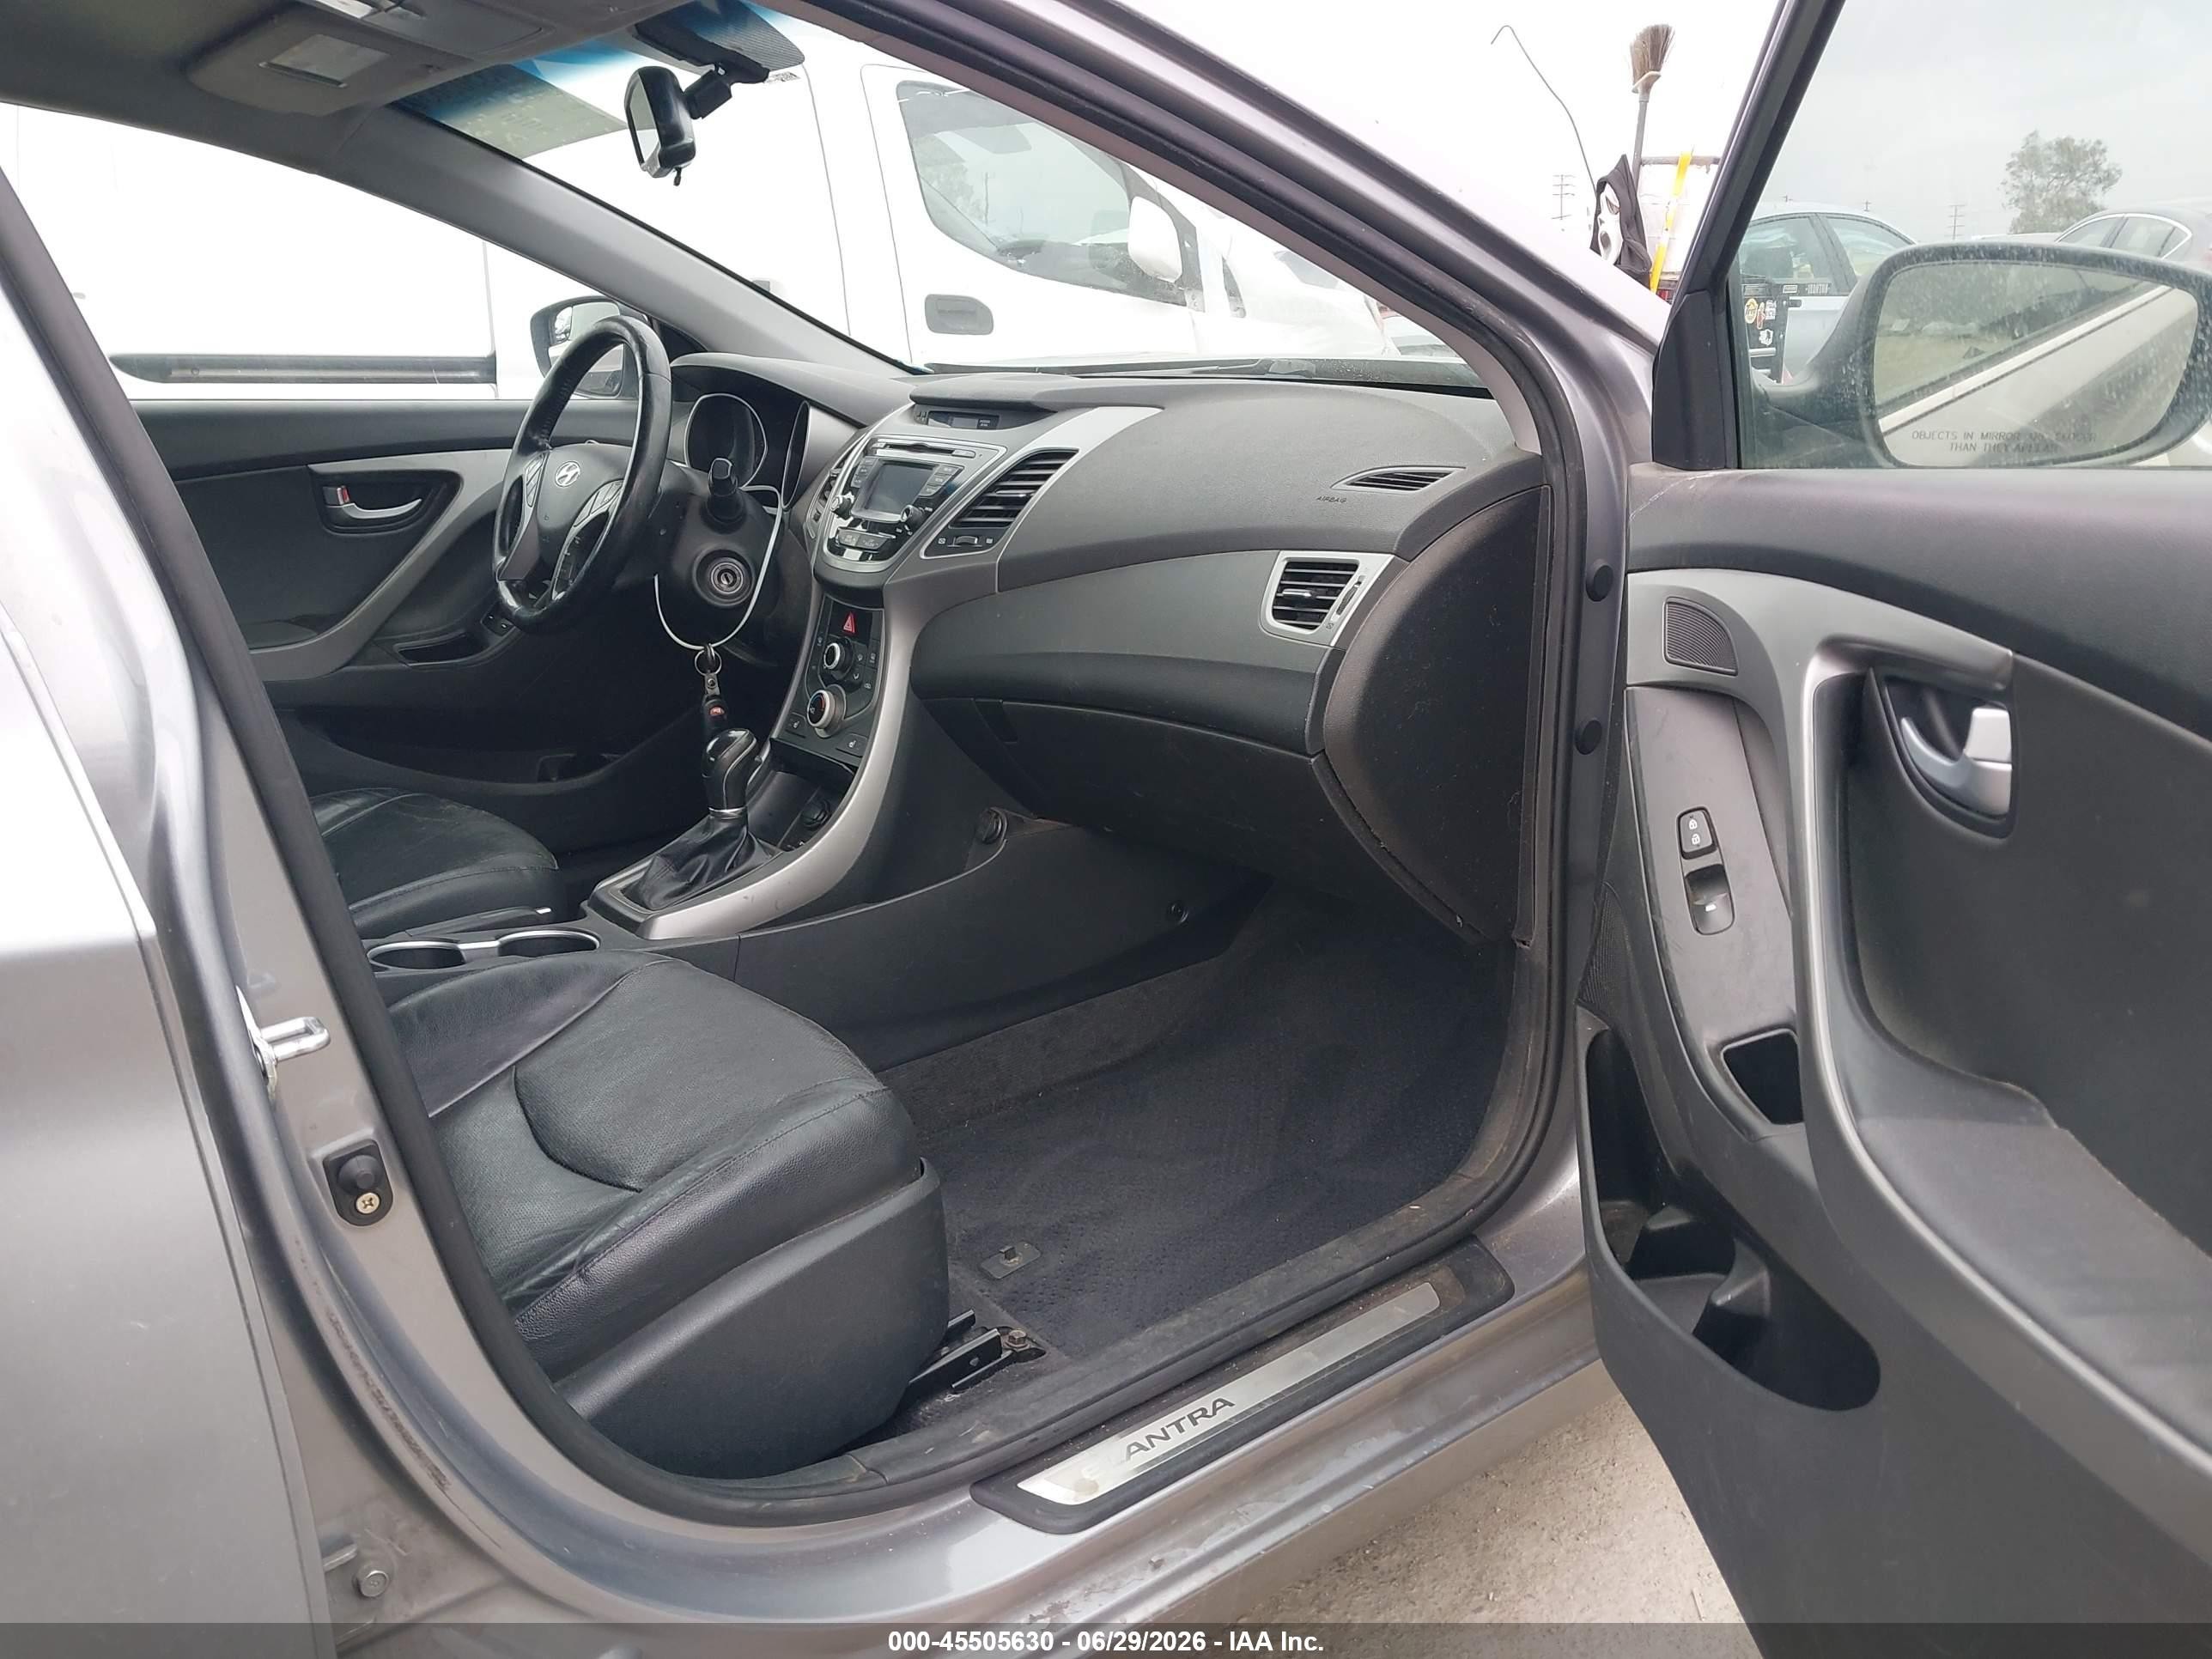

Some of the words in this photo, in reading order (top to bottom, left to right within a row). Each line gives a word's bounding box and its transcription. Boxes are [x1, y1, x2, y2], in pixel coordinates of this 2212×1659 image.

[1911, 430, 1958, 441] OBJECTS
[1963, 431, 1974, 441] IN
[1980, 432, 2021, 441] MIRROR
[1950, 441, 1978, 452] THAN
